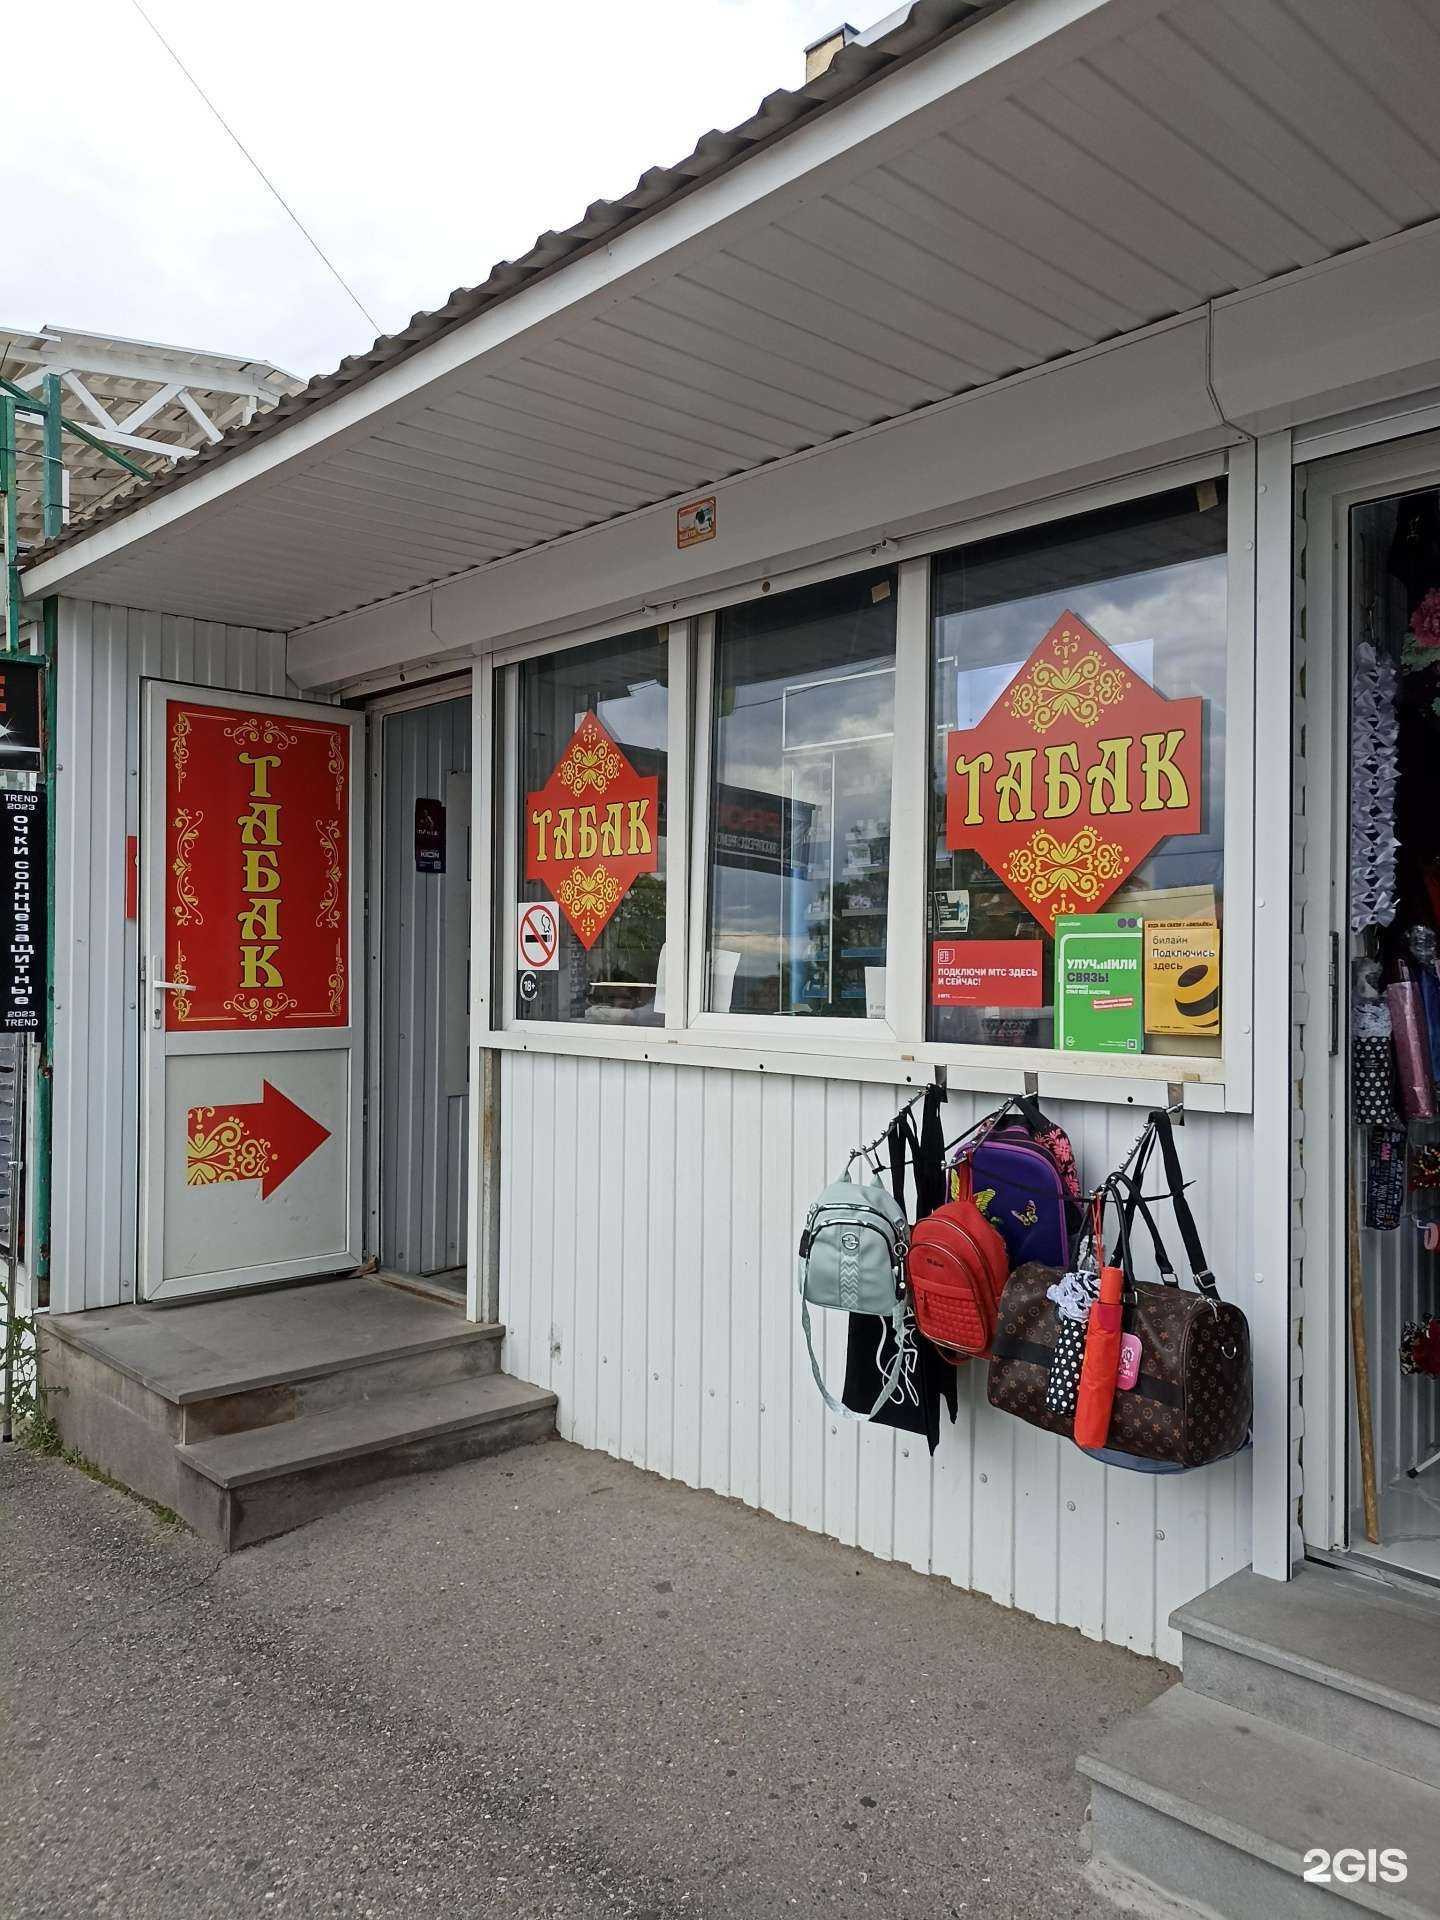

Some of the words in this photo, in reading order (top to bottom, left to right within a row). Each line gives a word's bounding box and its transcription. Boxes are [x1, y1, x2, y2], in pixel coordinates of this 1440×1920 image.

[955, 729, 1190, 825] ТАБАК
[4, 794, 38, 803] TREND
[7, 803, 36, 811] 2023
[532, 798, 652, 861] ТАБАК
[237, 752, 284, 988] ТАБАК
[1152, 935, 1188, 945] билайн
[1152, 949, 1216, 960] Подключись
[1152, 962, 1183, 972] здесь
[937, 968, 987, 977] ПОДКЛЮЧИ
[988, 968, 1007, 977] МТС
[1008, 968, 1038, 978] ЗДЕСЬ
[1066, 972, 1109, 983] СВЯЗЬ!
[523, 980, 536, 992] 18+
[945, 976, 981, 986] СЕЙЧАС!
[5, 1018, 39, 1027] TREND
